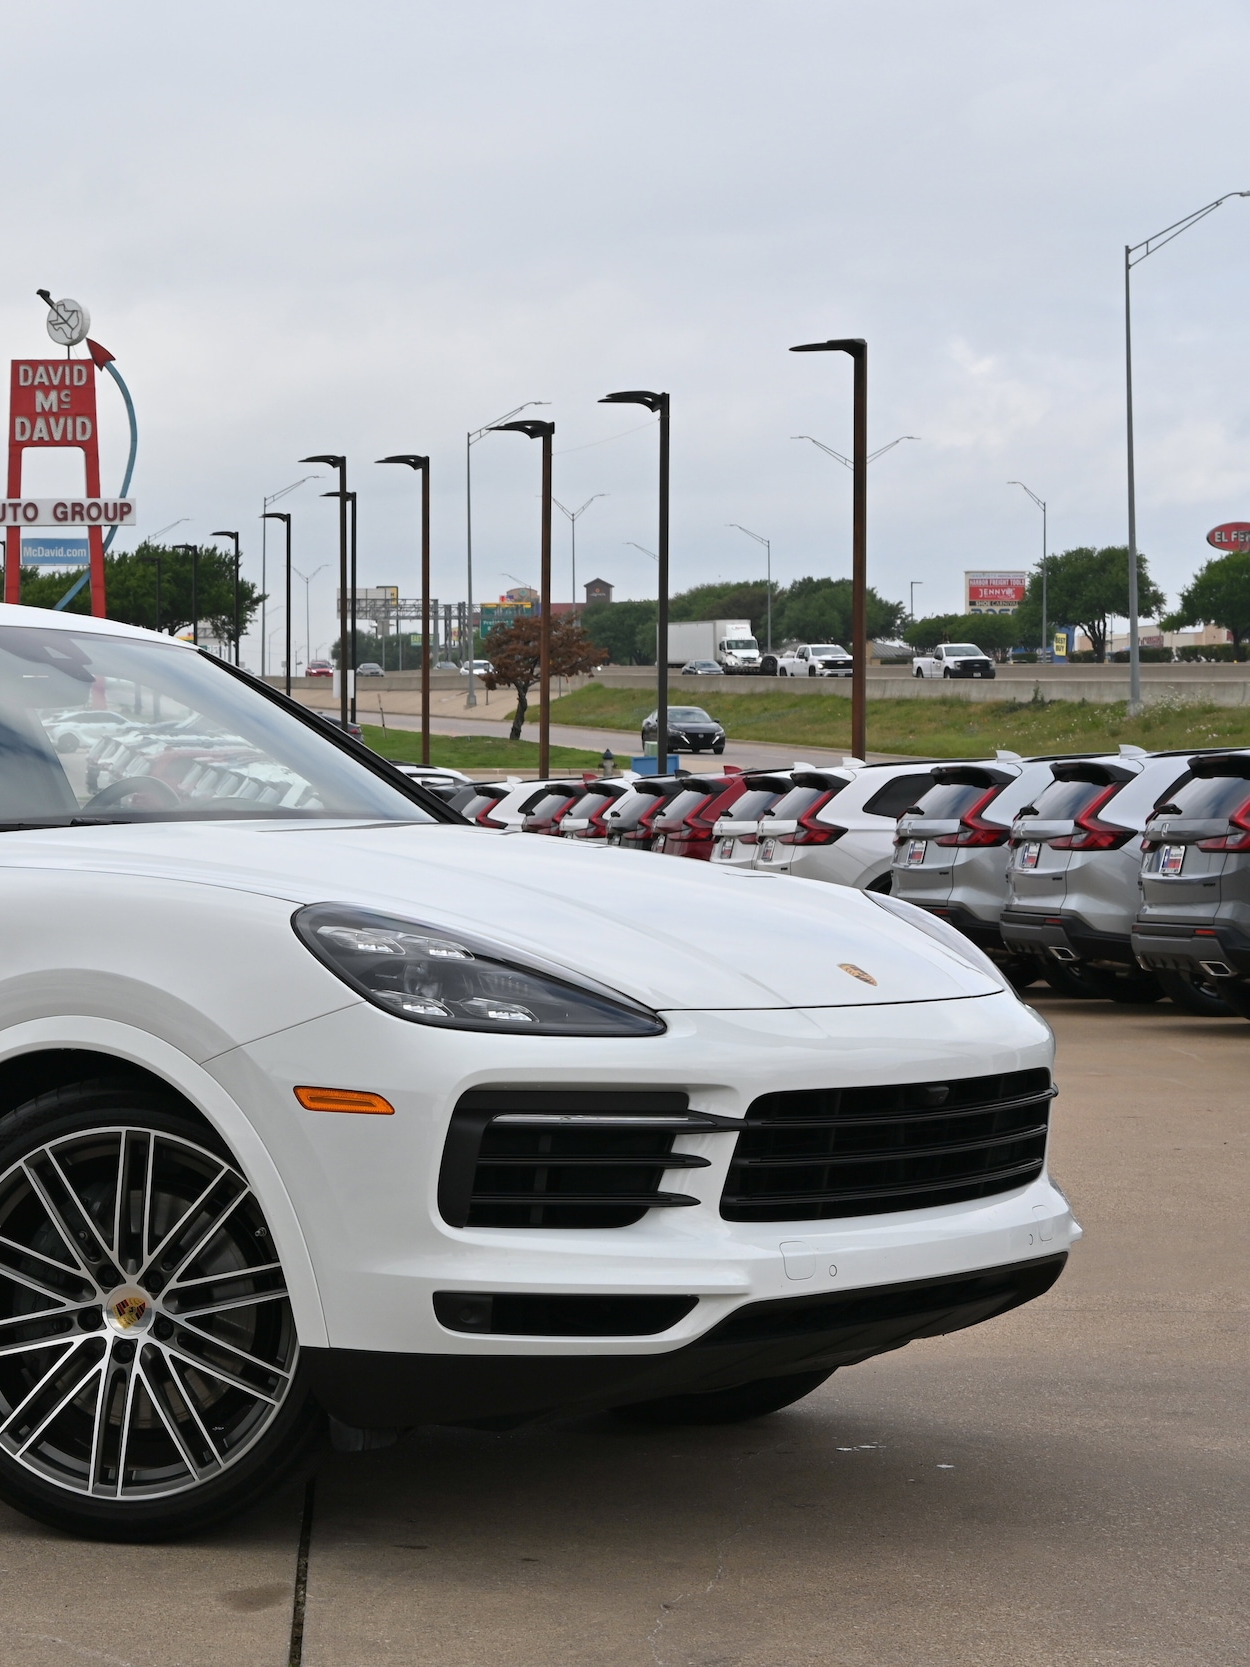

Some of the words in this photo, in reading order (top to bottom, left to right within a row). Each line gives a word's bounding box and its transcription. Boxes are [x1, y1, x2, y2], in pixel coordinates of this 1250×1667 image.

[19, 364, 87, 386] DAVID
[14, 416, 92, 441] DAVID
[53, 502, 132, 522] GROUP
[1215, 531, 1228, 542] EL
[23, 546, 87, 557] McDavid.com
